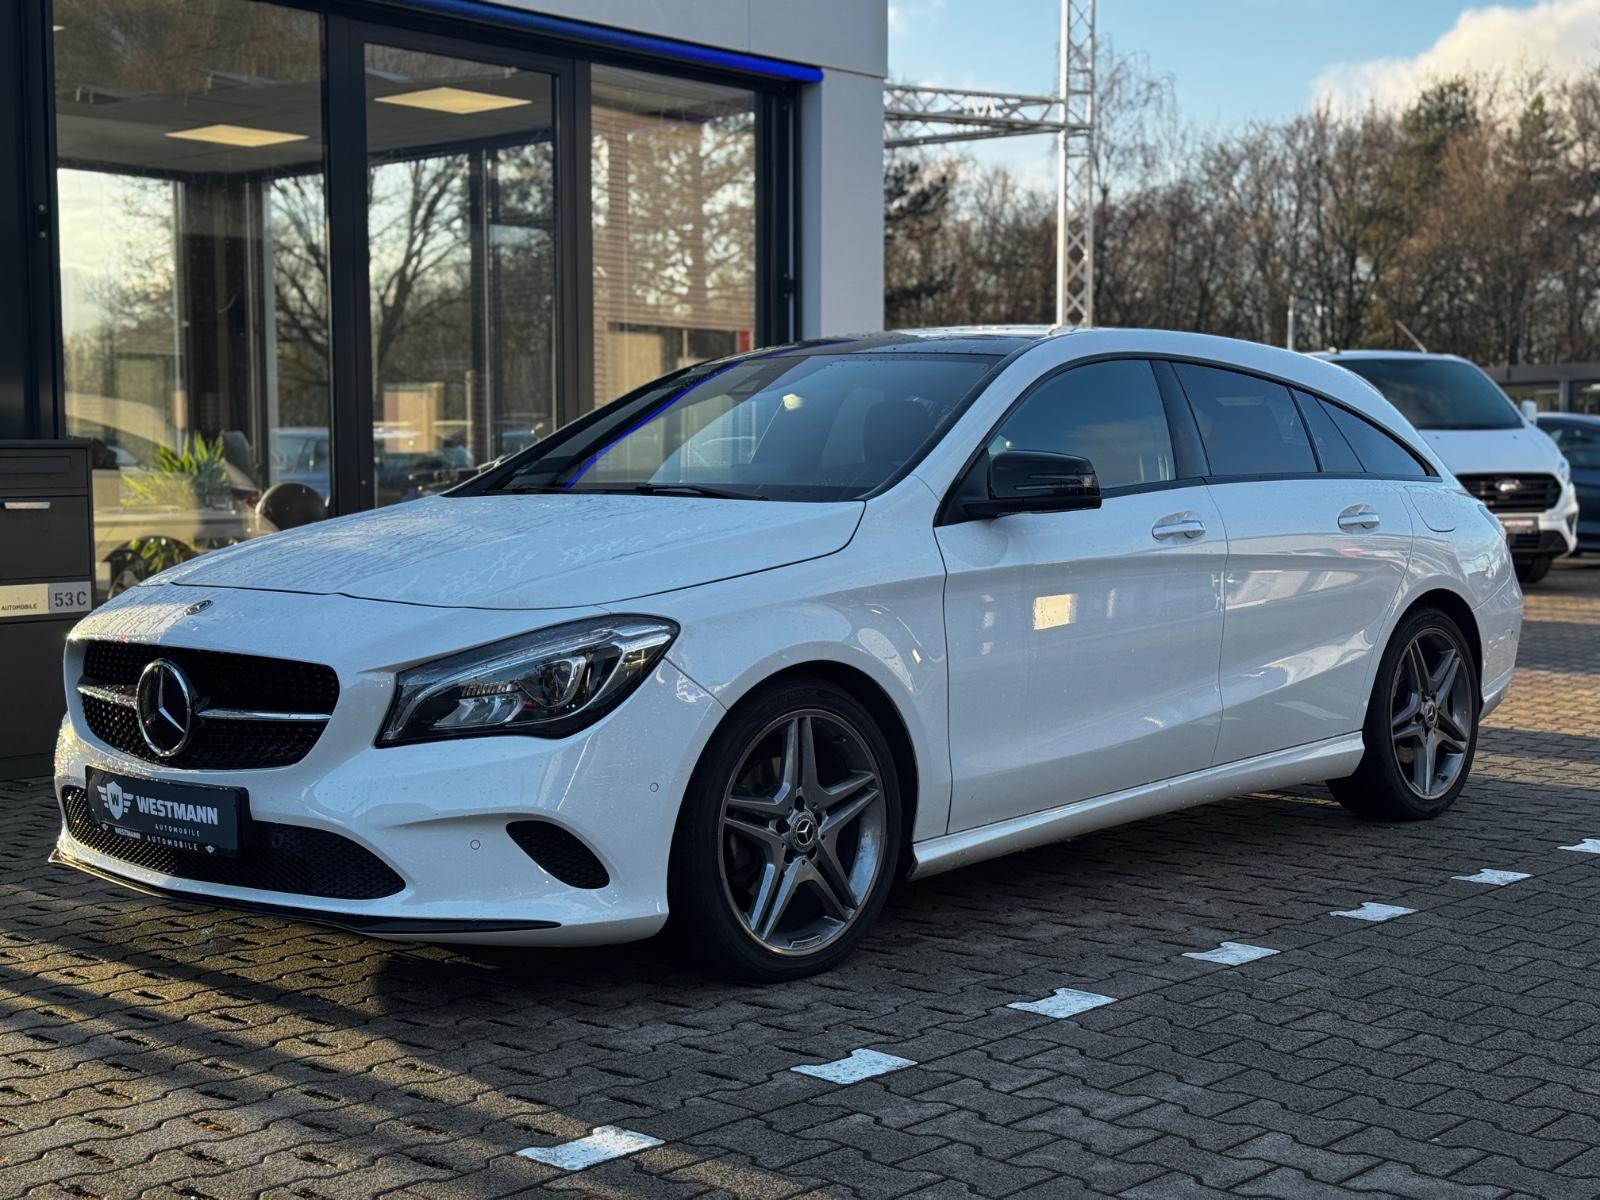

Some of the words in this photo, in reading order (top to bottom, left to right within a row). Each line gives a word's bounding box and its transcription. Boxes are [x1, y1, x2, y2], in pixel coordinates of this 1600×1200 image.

[1, 603, 37, 611] AUTOMOBILE
[110, 792, 119, 807] W
[136, 795, 218, 825] WESTMANN
[155, 823, 200, 837] AUTOMOBILE
[114, 827, 141, 839] WESTMANN
[147, 835, 198, 851] AUTOMOBILE
